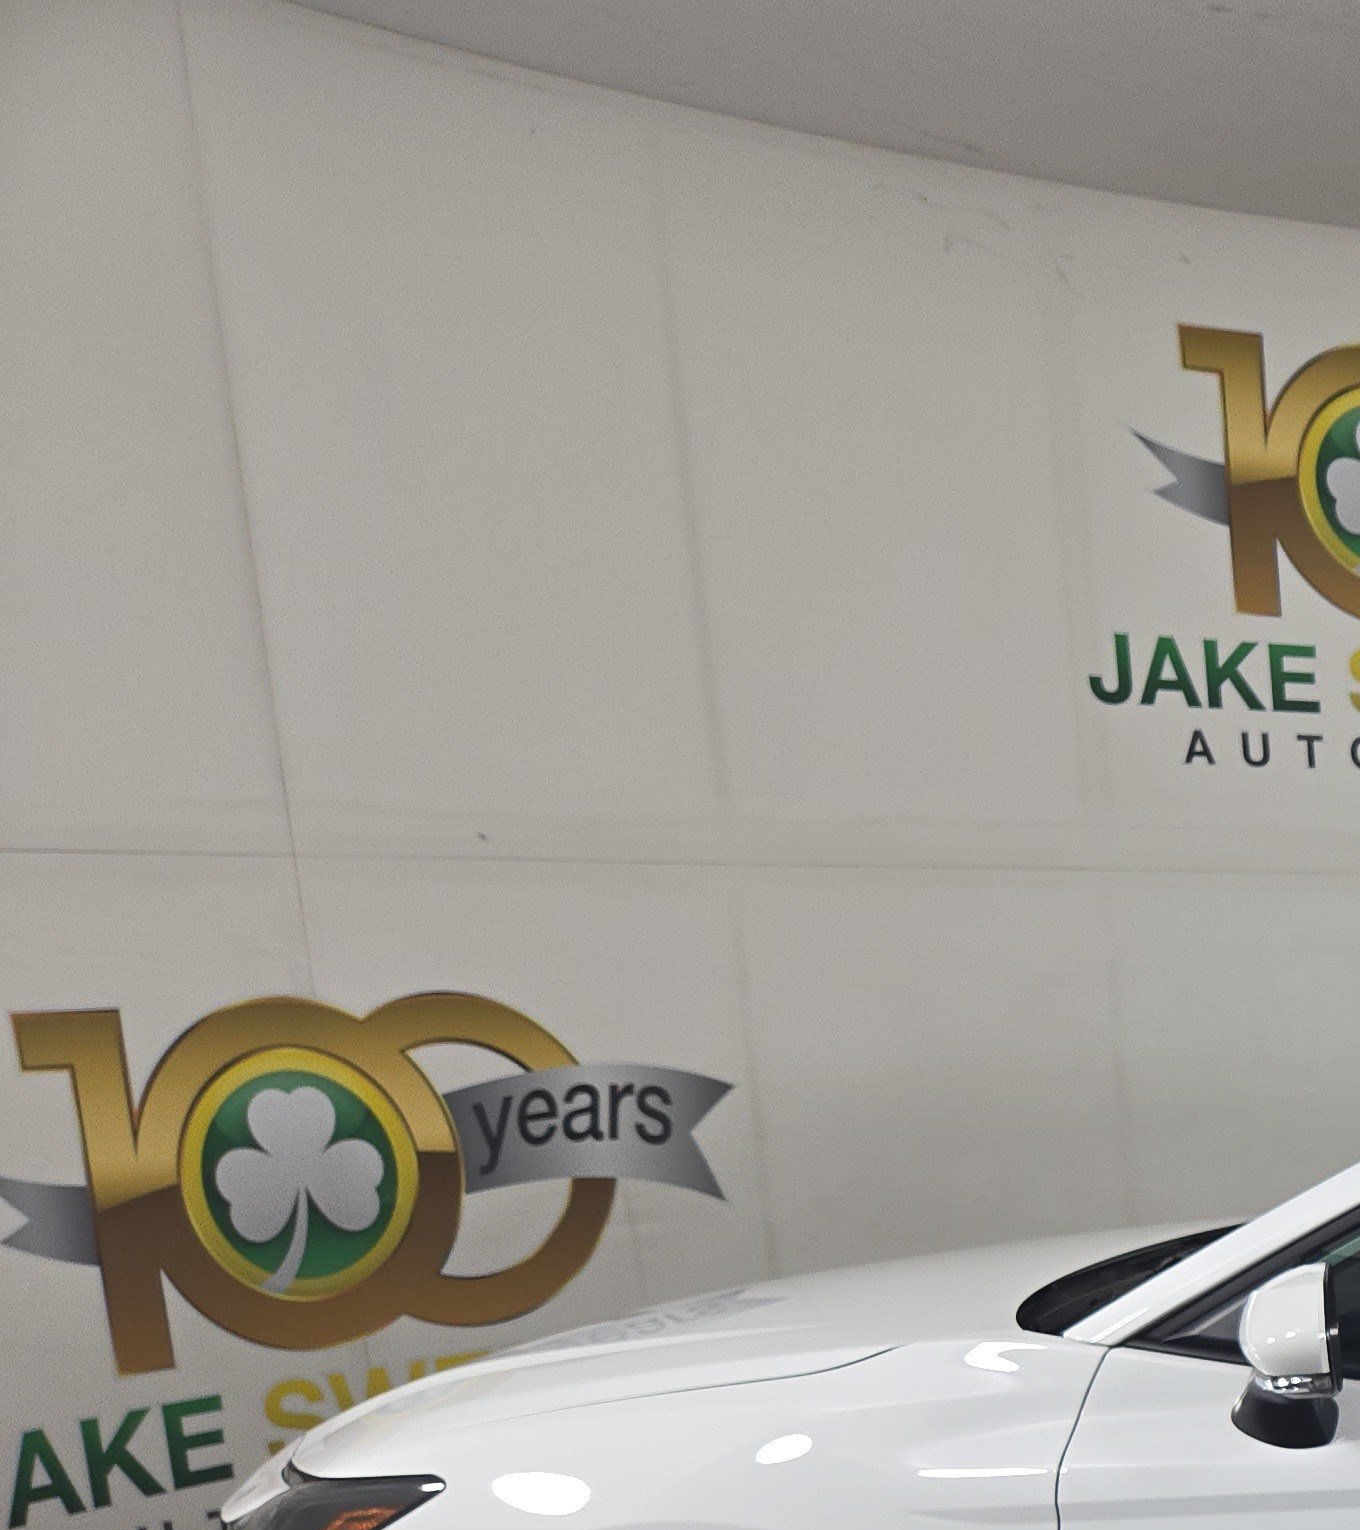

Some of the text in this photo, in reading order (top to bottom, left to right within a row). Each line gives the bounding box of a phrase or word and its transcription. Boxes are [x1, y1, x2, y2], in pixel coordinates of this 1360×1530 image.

[1088, 631, 1321, 714] JAKE
[9, 989, 675, 1376] 100 years
[7, 1394, 235, 1530] AKE
